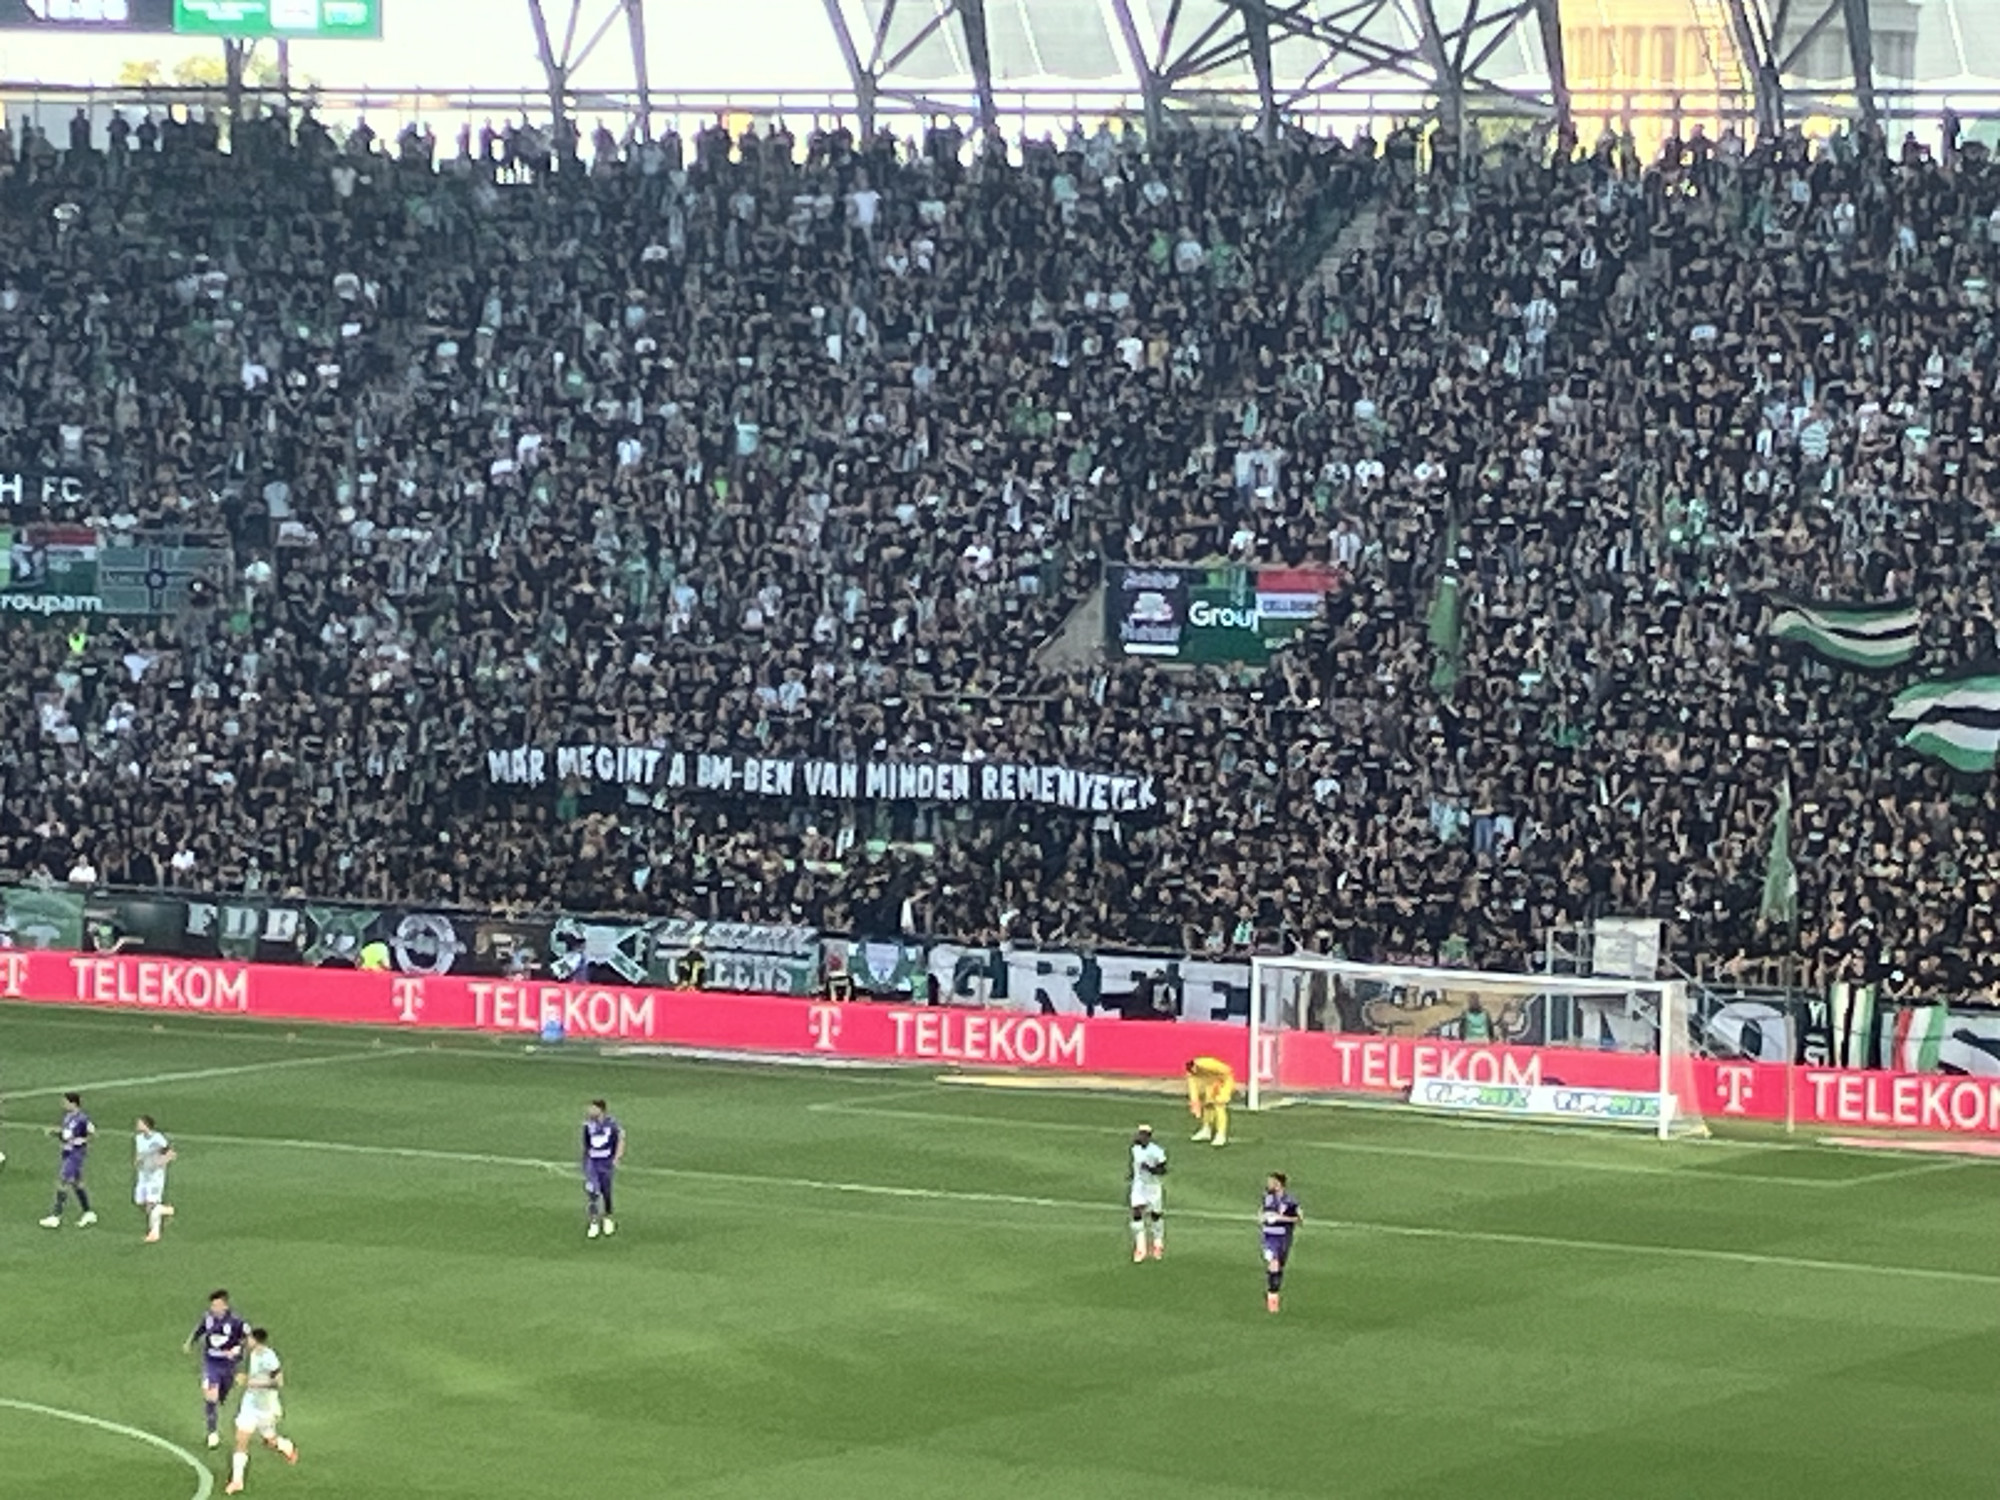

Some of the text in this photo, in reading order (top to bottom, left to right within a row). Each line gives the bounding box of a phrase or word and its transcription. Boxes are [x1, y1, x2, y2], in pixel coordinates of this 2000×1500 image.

[42, 477, 84, 503] FC
[667, 752, 686, 788] A
[803, 762, 858, 798] VAN
[866, 762, 970, 800] MINDEN
[69, 957, 248, 1012] TELEKOM
[467, 982, 656, 1037] TELEKOM
[888, 1012, 1086, 1066] TELEKOM
[1332, 1040, 1542, 1087] TELEKOM
